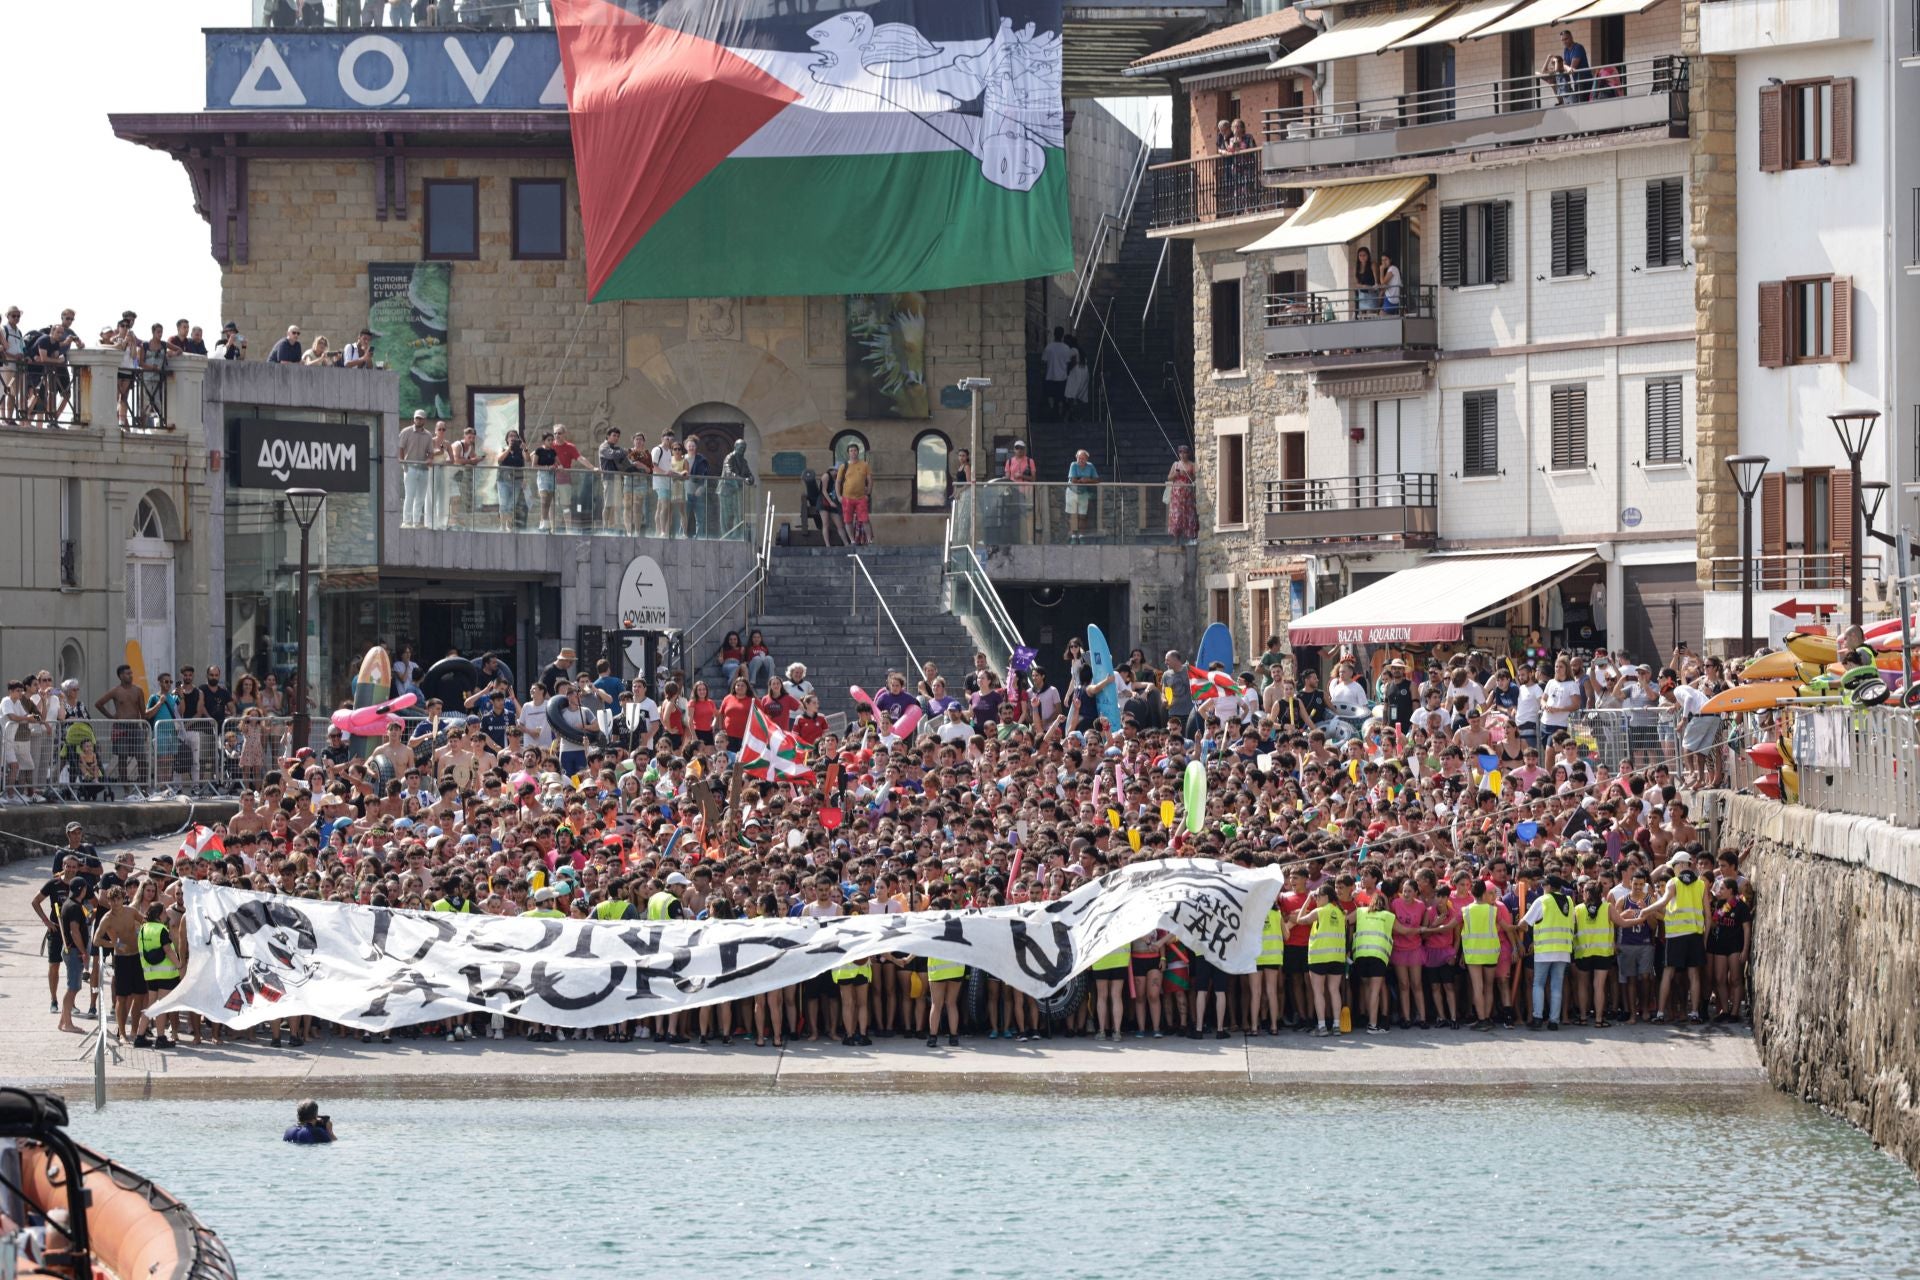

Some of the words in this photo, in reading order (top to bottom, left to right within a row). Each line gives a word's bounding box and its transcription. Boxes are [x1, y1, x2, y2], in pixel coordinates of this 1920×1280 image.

[257, 439, 356, 482] AQVARIVM
[1338, 629, 1363, 642] BAZAR
[1368, 627, 1411, 643] AQUARIUM
